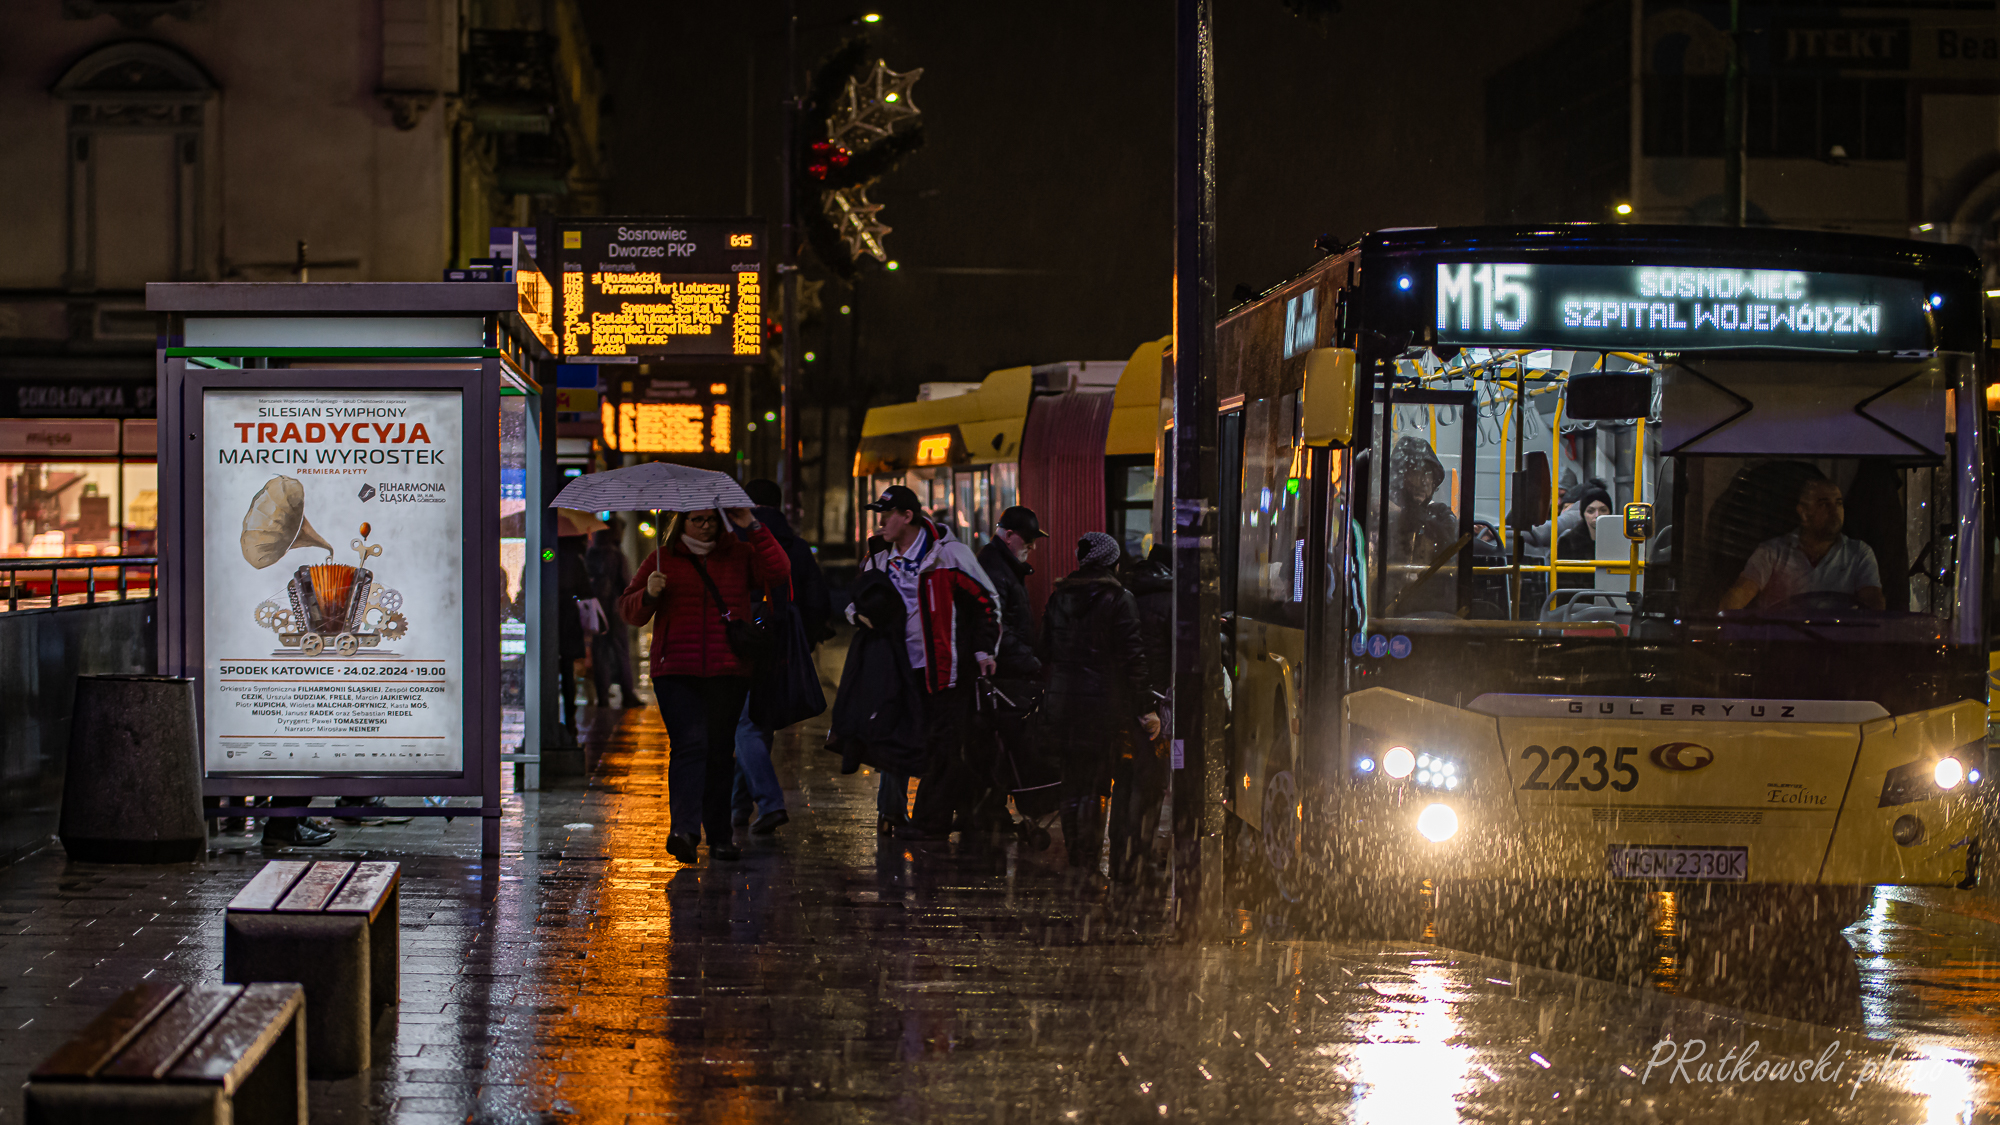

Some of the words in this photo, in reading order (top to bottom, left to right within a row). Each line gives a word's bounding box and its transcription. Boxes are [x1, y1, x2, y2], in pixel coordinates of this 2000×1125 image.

[1785, 28, 1898, 61] JTEKT
[617, 226, 687, 241] Sosnowiec
[730, 234, 753, 247] 6:15
[608, 244, 664, 258] Dworzec
[668, 244, 696, 257] PKP
[599, 262, 636, 272] kierunek
[602, 282, 654, 294] Pyrzowice
[654, 282, 678, 294] Port
[679, 282, 725, 294] Lotniczy
[1640, 270, 1803, 300] SOSNOWIEC
[672, 292, 724, 304] Sosnowiec
[1437, 264, 1528, 330] M15
[621, 302, 674, 314] Sosnowiec
[1564, 302, 1686, 330] SZPITAL
[1694, 302, 1878, 334] WOJEWÓDZKI
[592, 323, 644, 334] Sosnowiec
[258, 407, 321, 417] SILESIAN
[326, 408, 406, 418] SYMPHONY
[234, 422, 432, 444] TRADYCYJA
[219, 449, 308, 464] MARCIN
[316, 449, 445, 464] WYROSTEK
[379, 482, 446, 492] FILHARMONIA
[380, 491, 416, 504] ŚLĄSKA
[220, 666, 268, 675] SPODEK
[272, 667, 334, 675] KATOWICE
[344, 667, 408, 676] 24.02.2024
[416, 667, 446, 676] 19.00
[1520, 745, 1640, 792] 2235
[1767, 788, 1827, 805] Ecoline
[1675, 853, 1743, 876] 2330K
